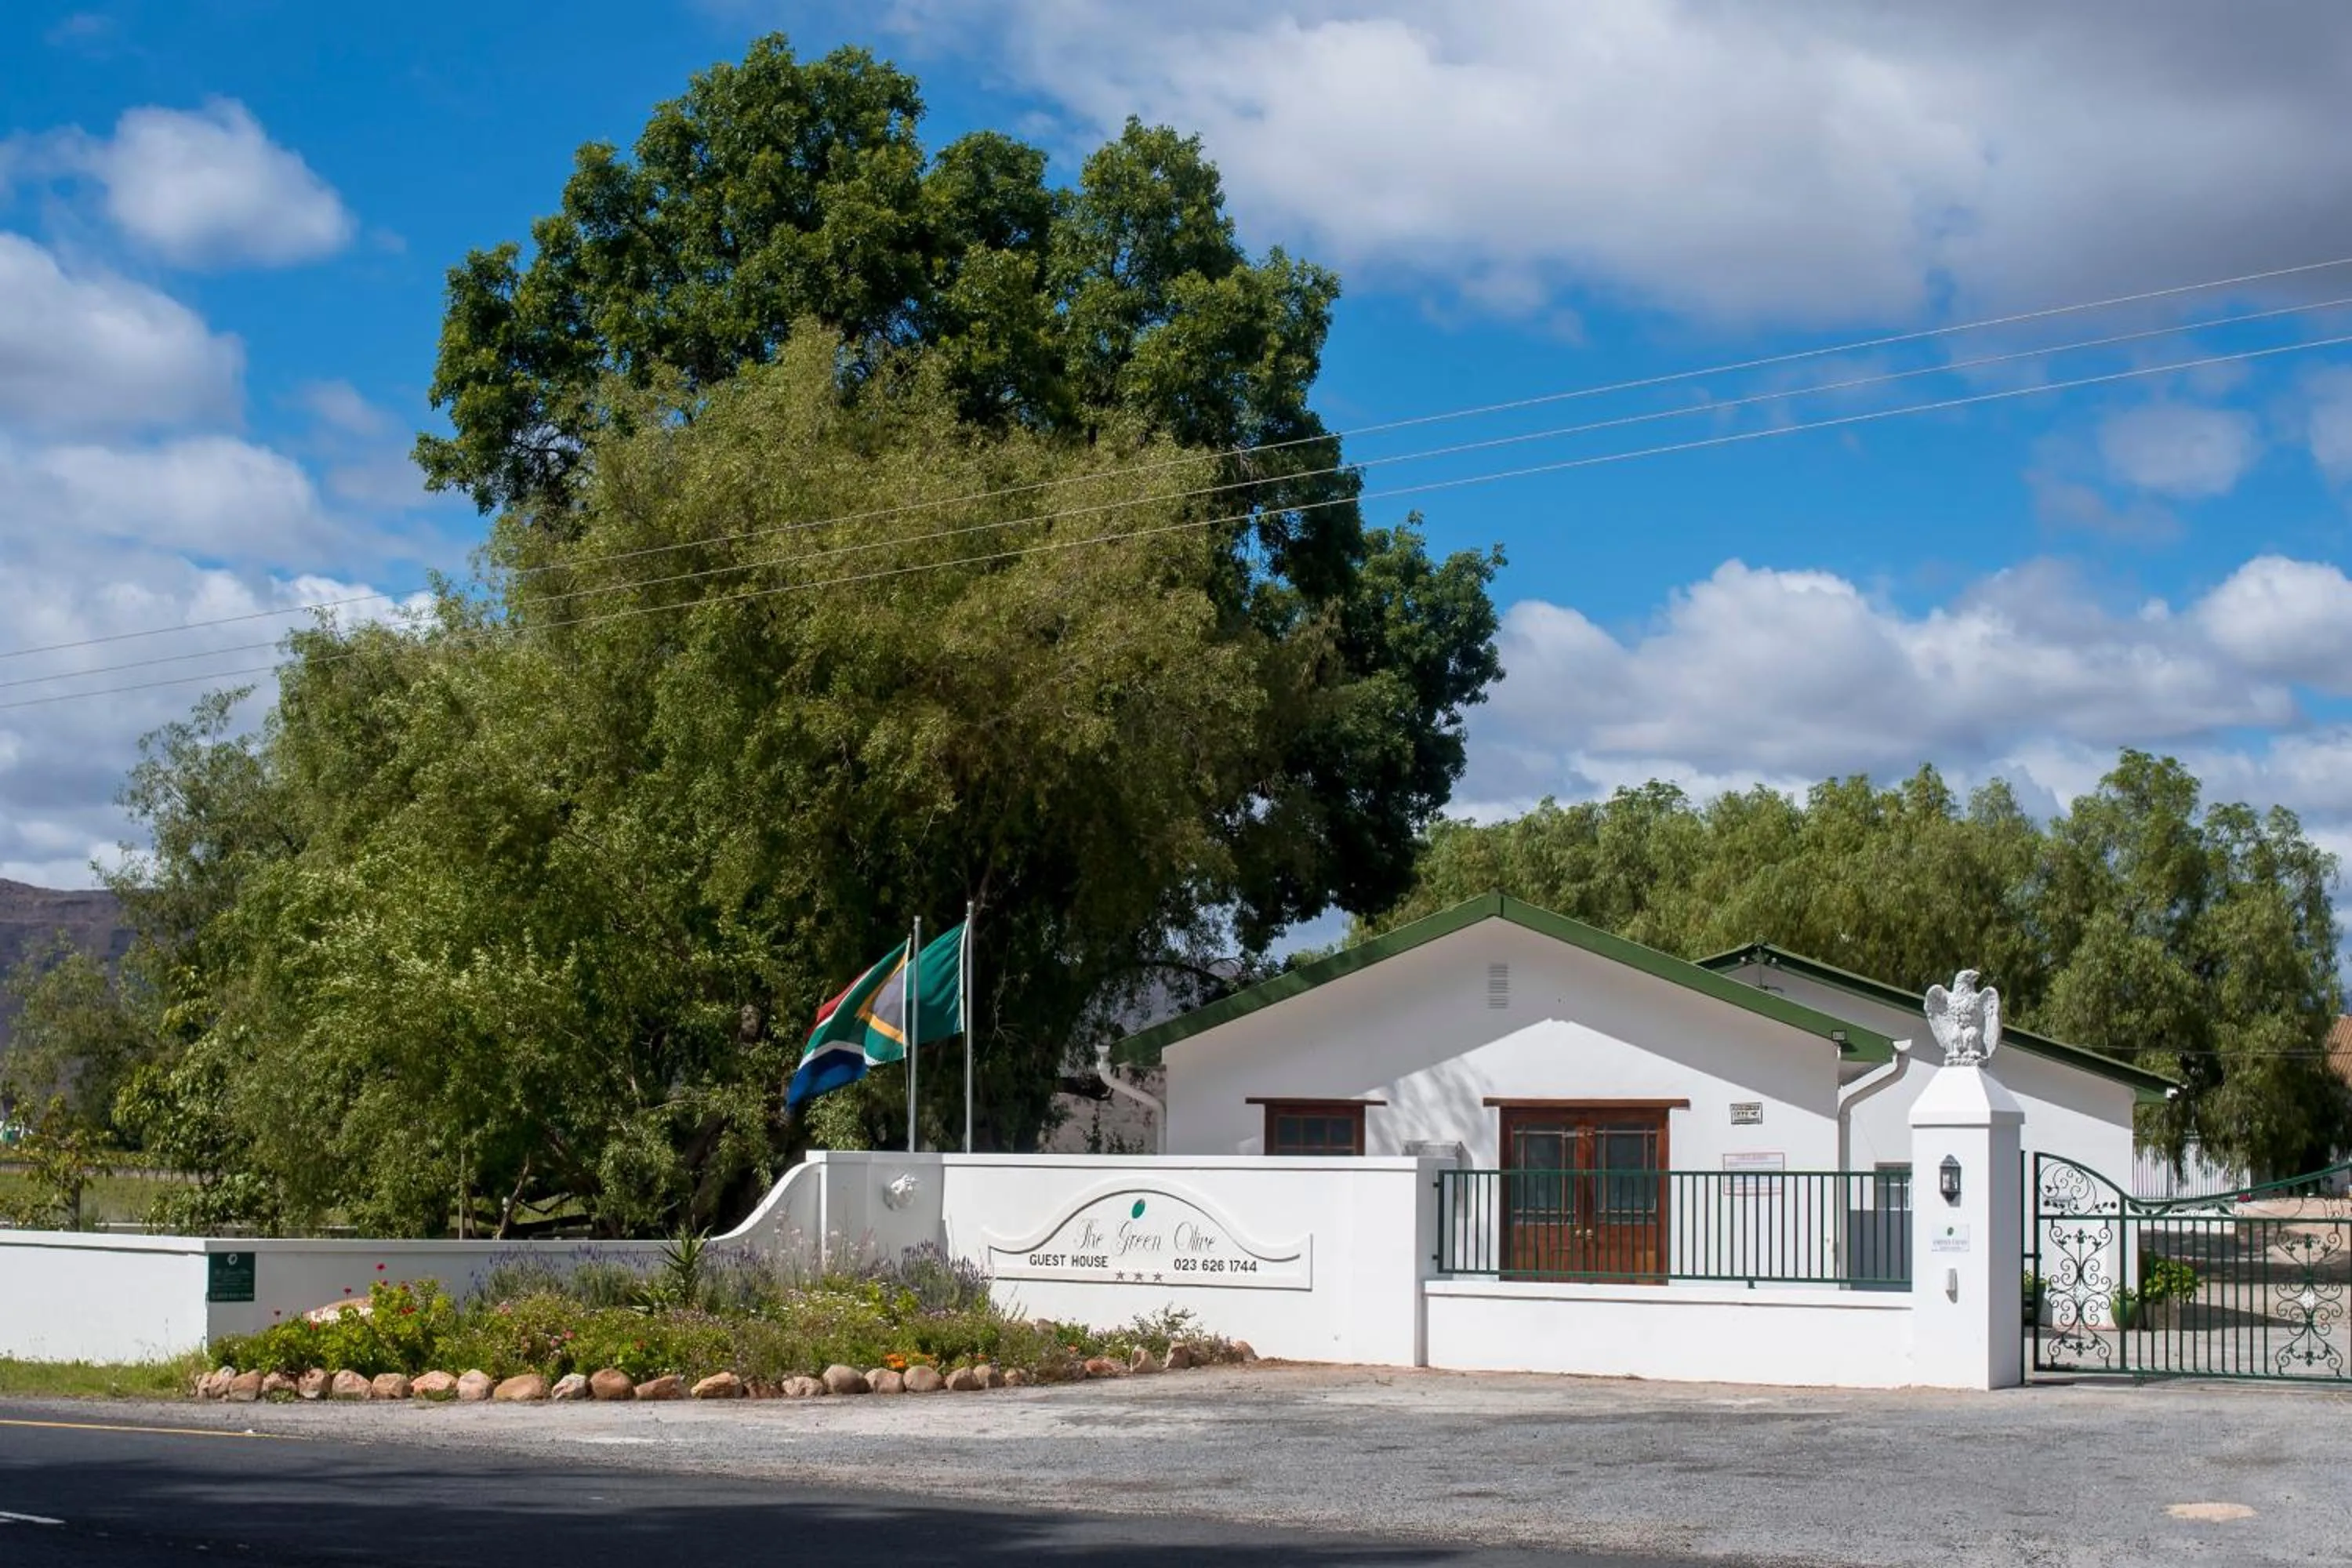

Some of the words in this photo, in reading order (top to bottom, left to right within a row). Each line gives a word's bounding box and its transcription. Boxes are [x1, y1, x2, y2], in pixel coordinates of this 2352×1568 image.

[1074, 1218, 1104, 1249] The
[1113, 1220, 1161, 1256] Green
[1174, 1221, 1216, 1252] Olive
[1029, 1254, 1066, 1266] GUEST
[1071, 1255, 1109, 1268] HOUSE
[1174, 1258, 1197, 1271] 023
[1202, 1259, 1225, 1272] 626
[1229, 1260, 1257, 1272] 1744
